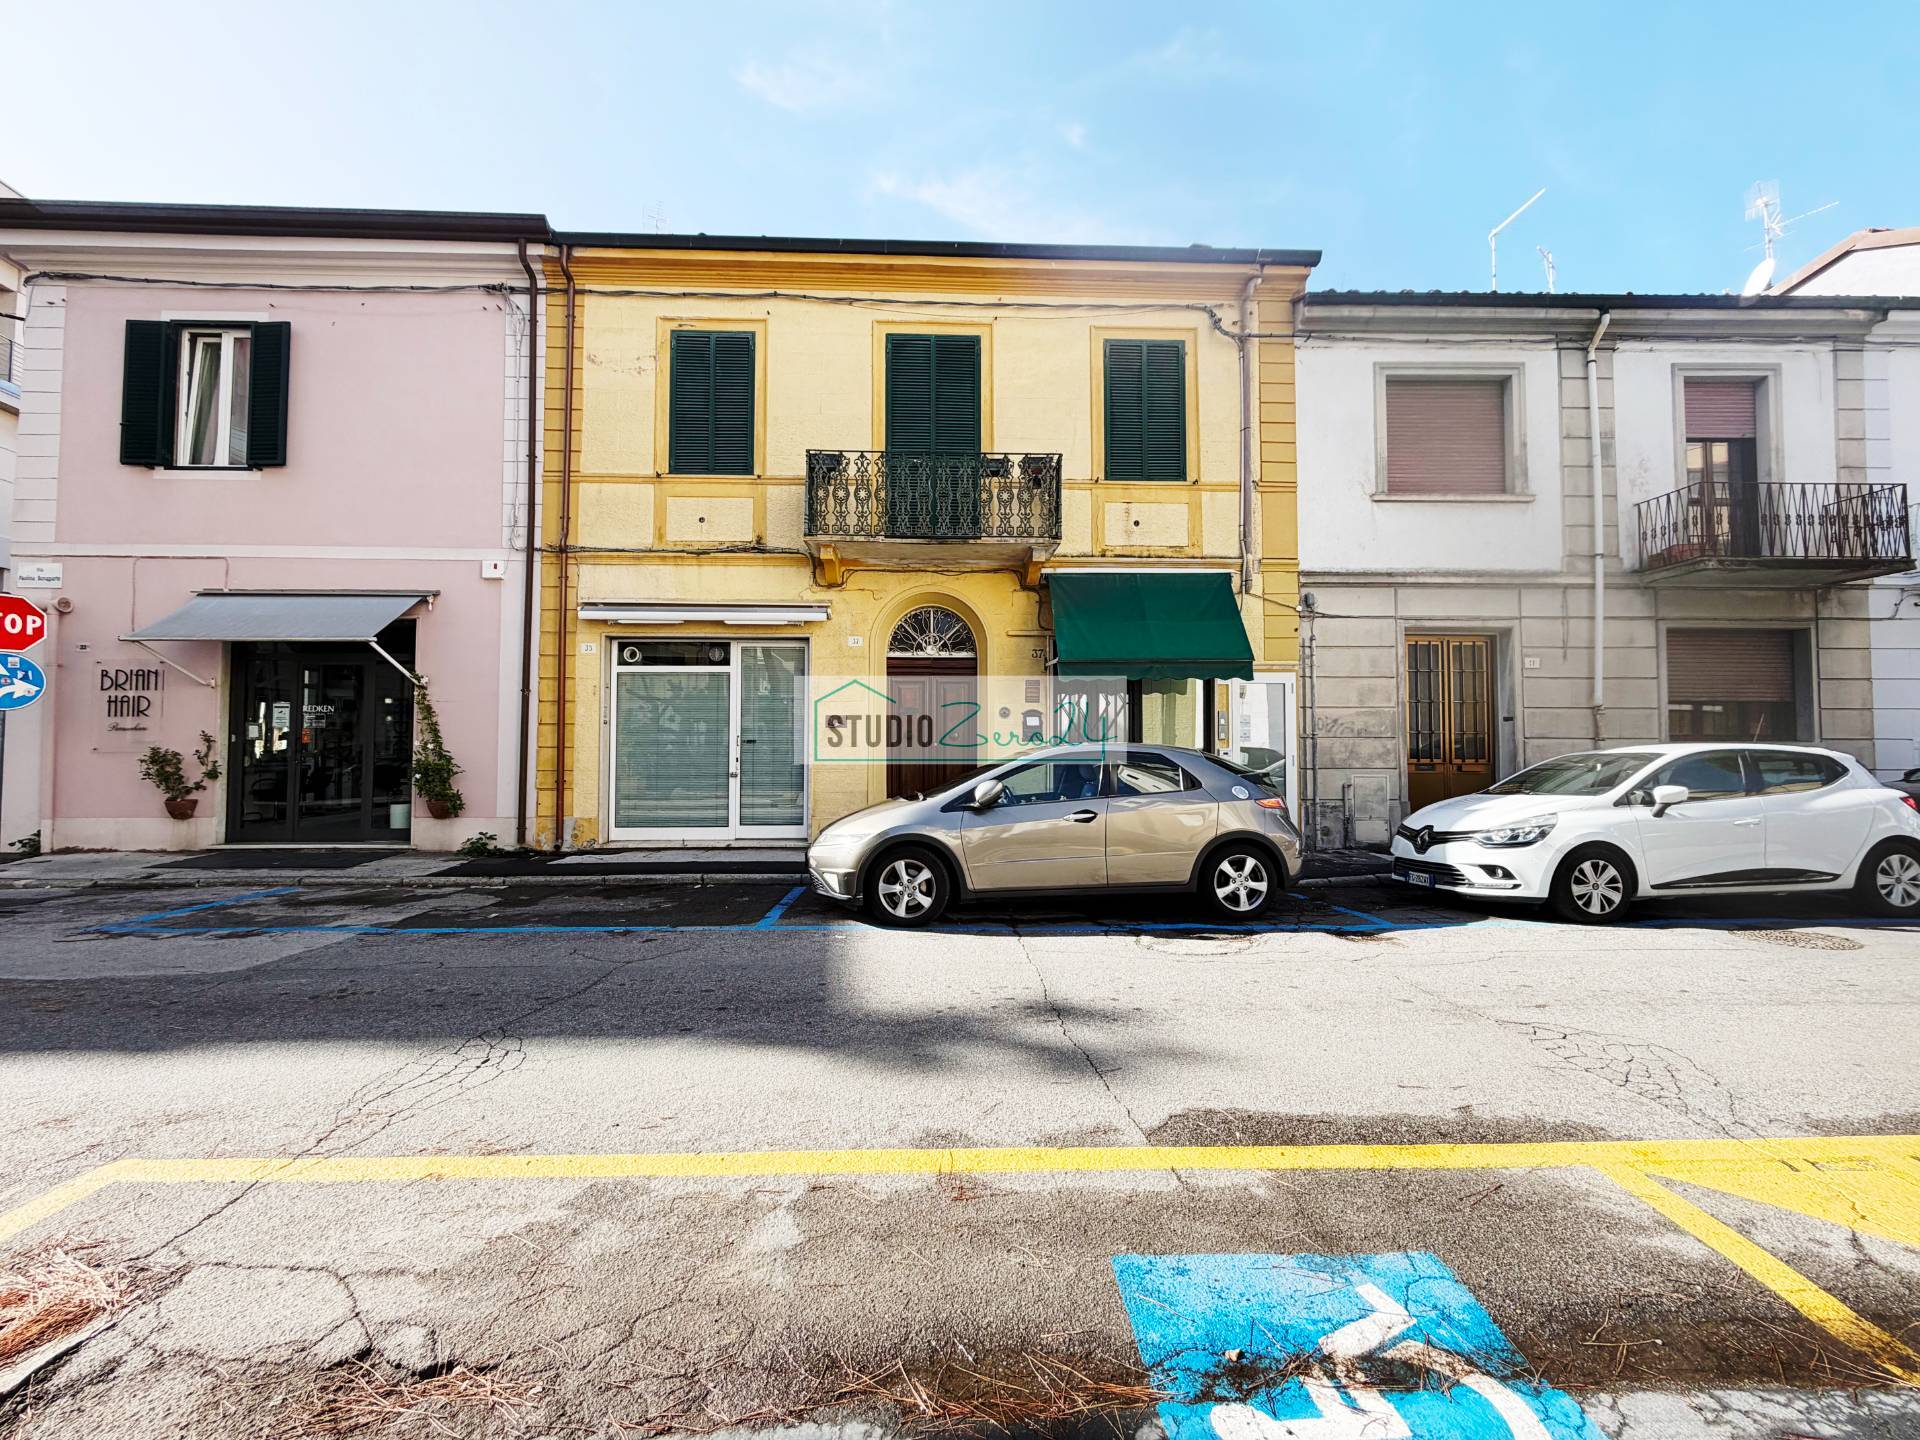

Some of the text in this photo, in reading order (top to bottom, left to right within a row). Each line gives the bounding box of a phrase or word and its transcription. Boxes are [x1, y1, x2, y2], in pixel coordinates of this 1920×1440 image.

[0, 612, 42, 636] OP
[100, 669, 159, 692] BRIAN
[106, 695, 151, 718] HAIR
[302, 704, 335, 713] REDKEN
